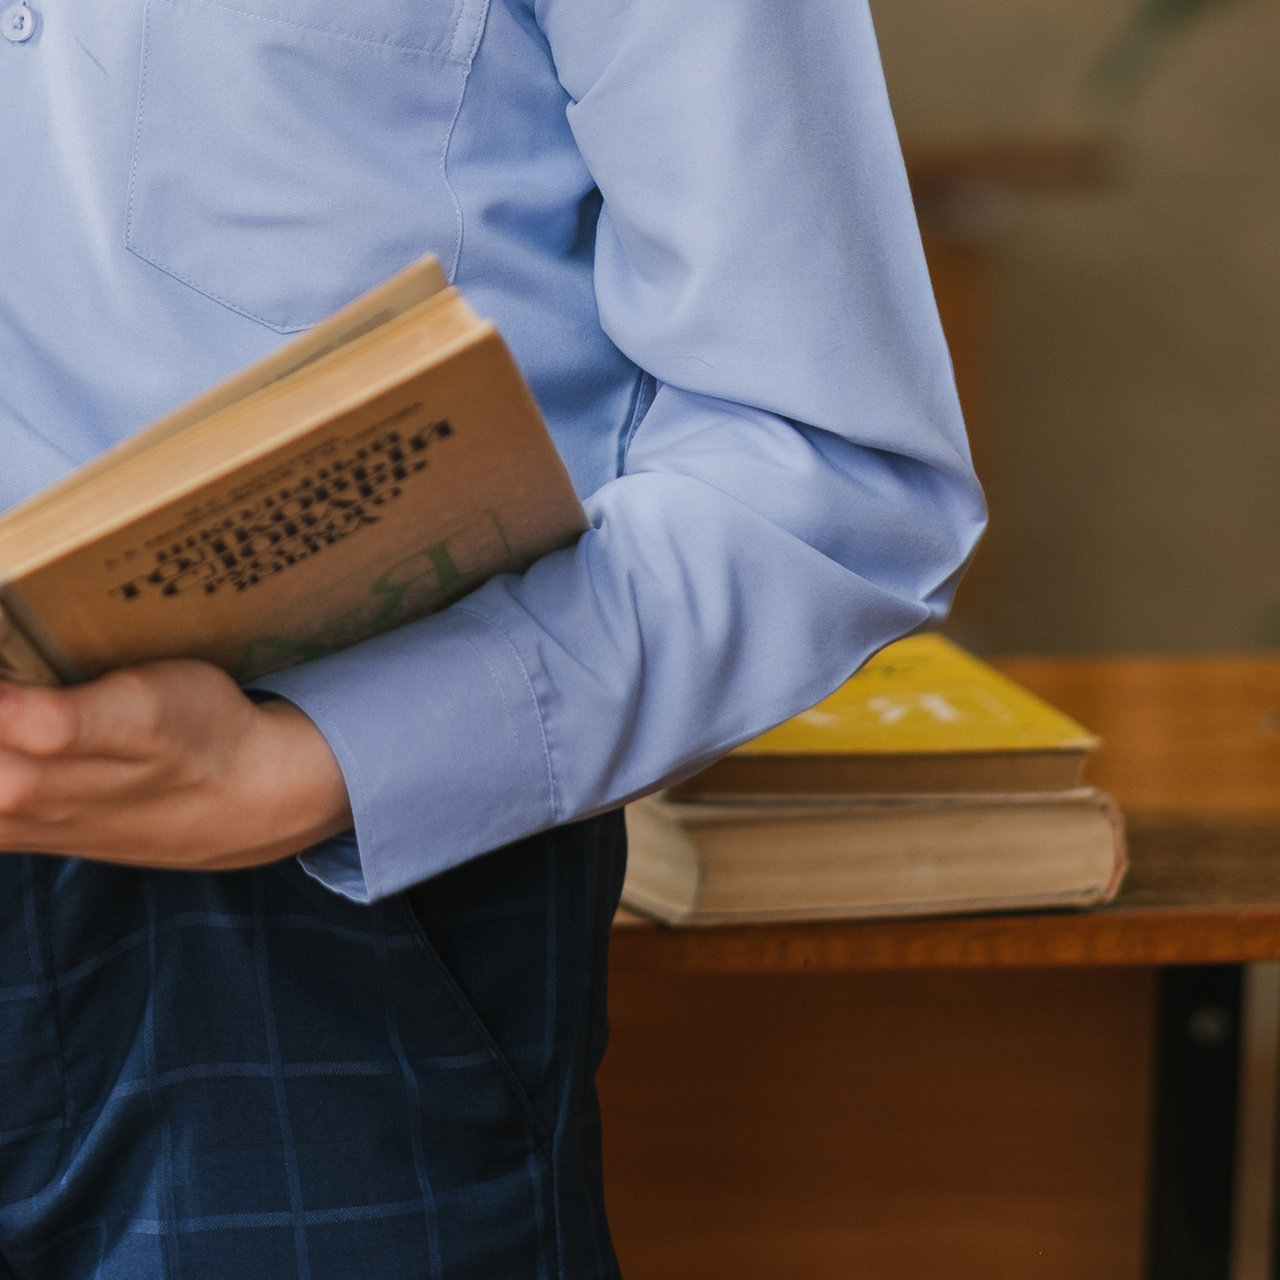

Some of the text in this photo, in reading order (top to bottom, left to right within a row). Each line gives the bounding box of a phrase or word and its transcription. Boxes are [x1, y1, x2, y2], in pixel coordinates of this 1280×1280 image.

[108, 417, 454, 599] ТОЛКОВЫЙ
[156, 430, 400, 562] ШКОЛЬНЫЙ
[161, 458, 428, 597] СЛОВАРЬ
[203, 486, 402, 595] РУССКОГО
[233, 516, 382, 593] ЯЗЫКА
